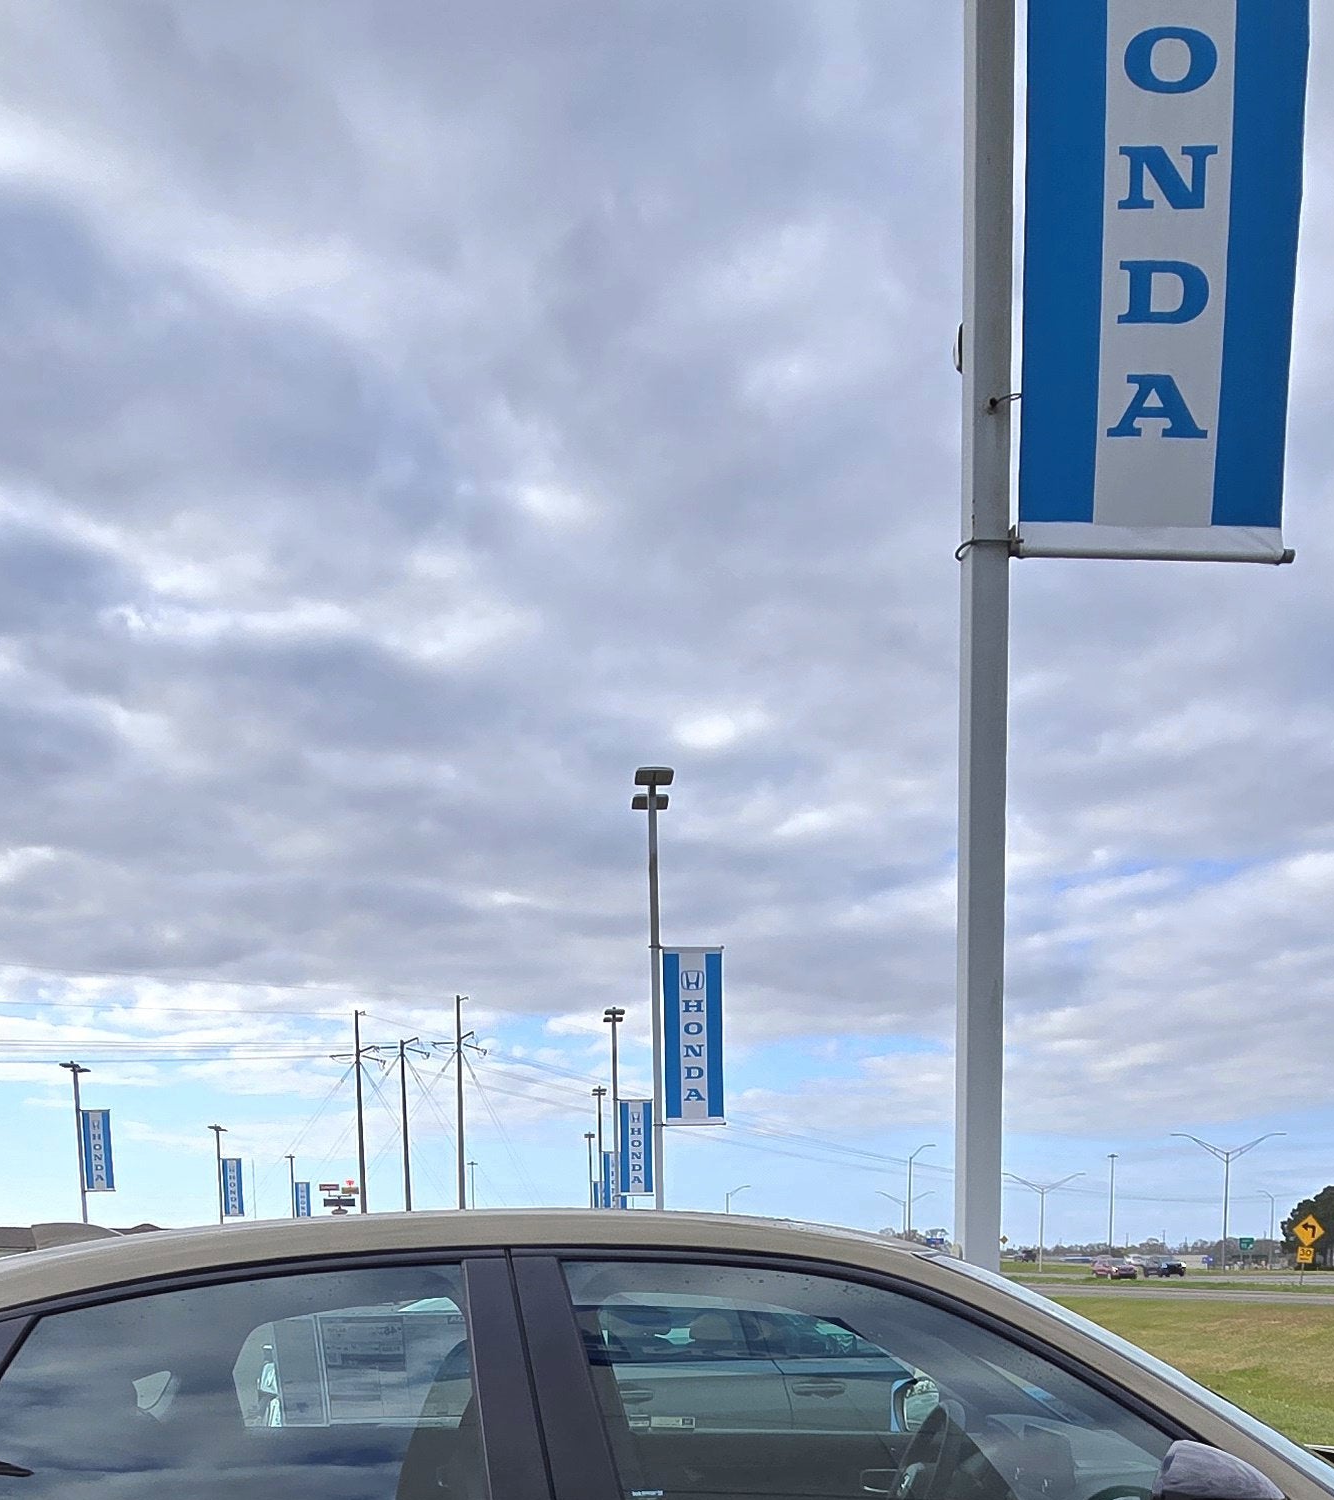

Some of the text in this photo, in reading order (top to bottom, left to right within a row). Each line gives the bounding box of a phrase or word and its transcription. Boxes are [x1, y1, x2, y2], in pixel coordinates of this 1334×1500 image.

[1106, 26, 1218, 440] ONDA
[682, 999, 706, 1101] HONDA
[92, 1133, 105, 1181] HONDA
[630, 1127, 643, 1184] HONDA
[1300, 1248, 1312, 1257] 30
